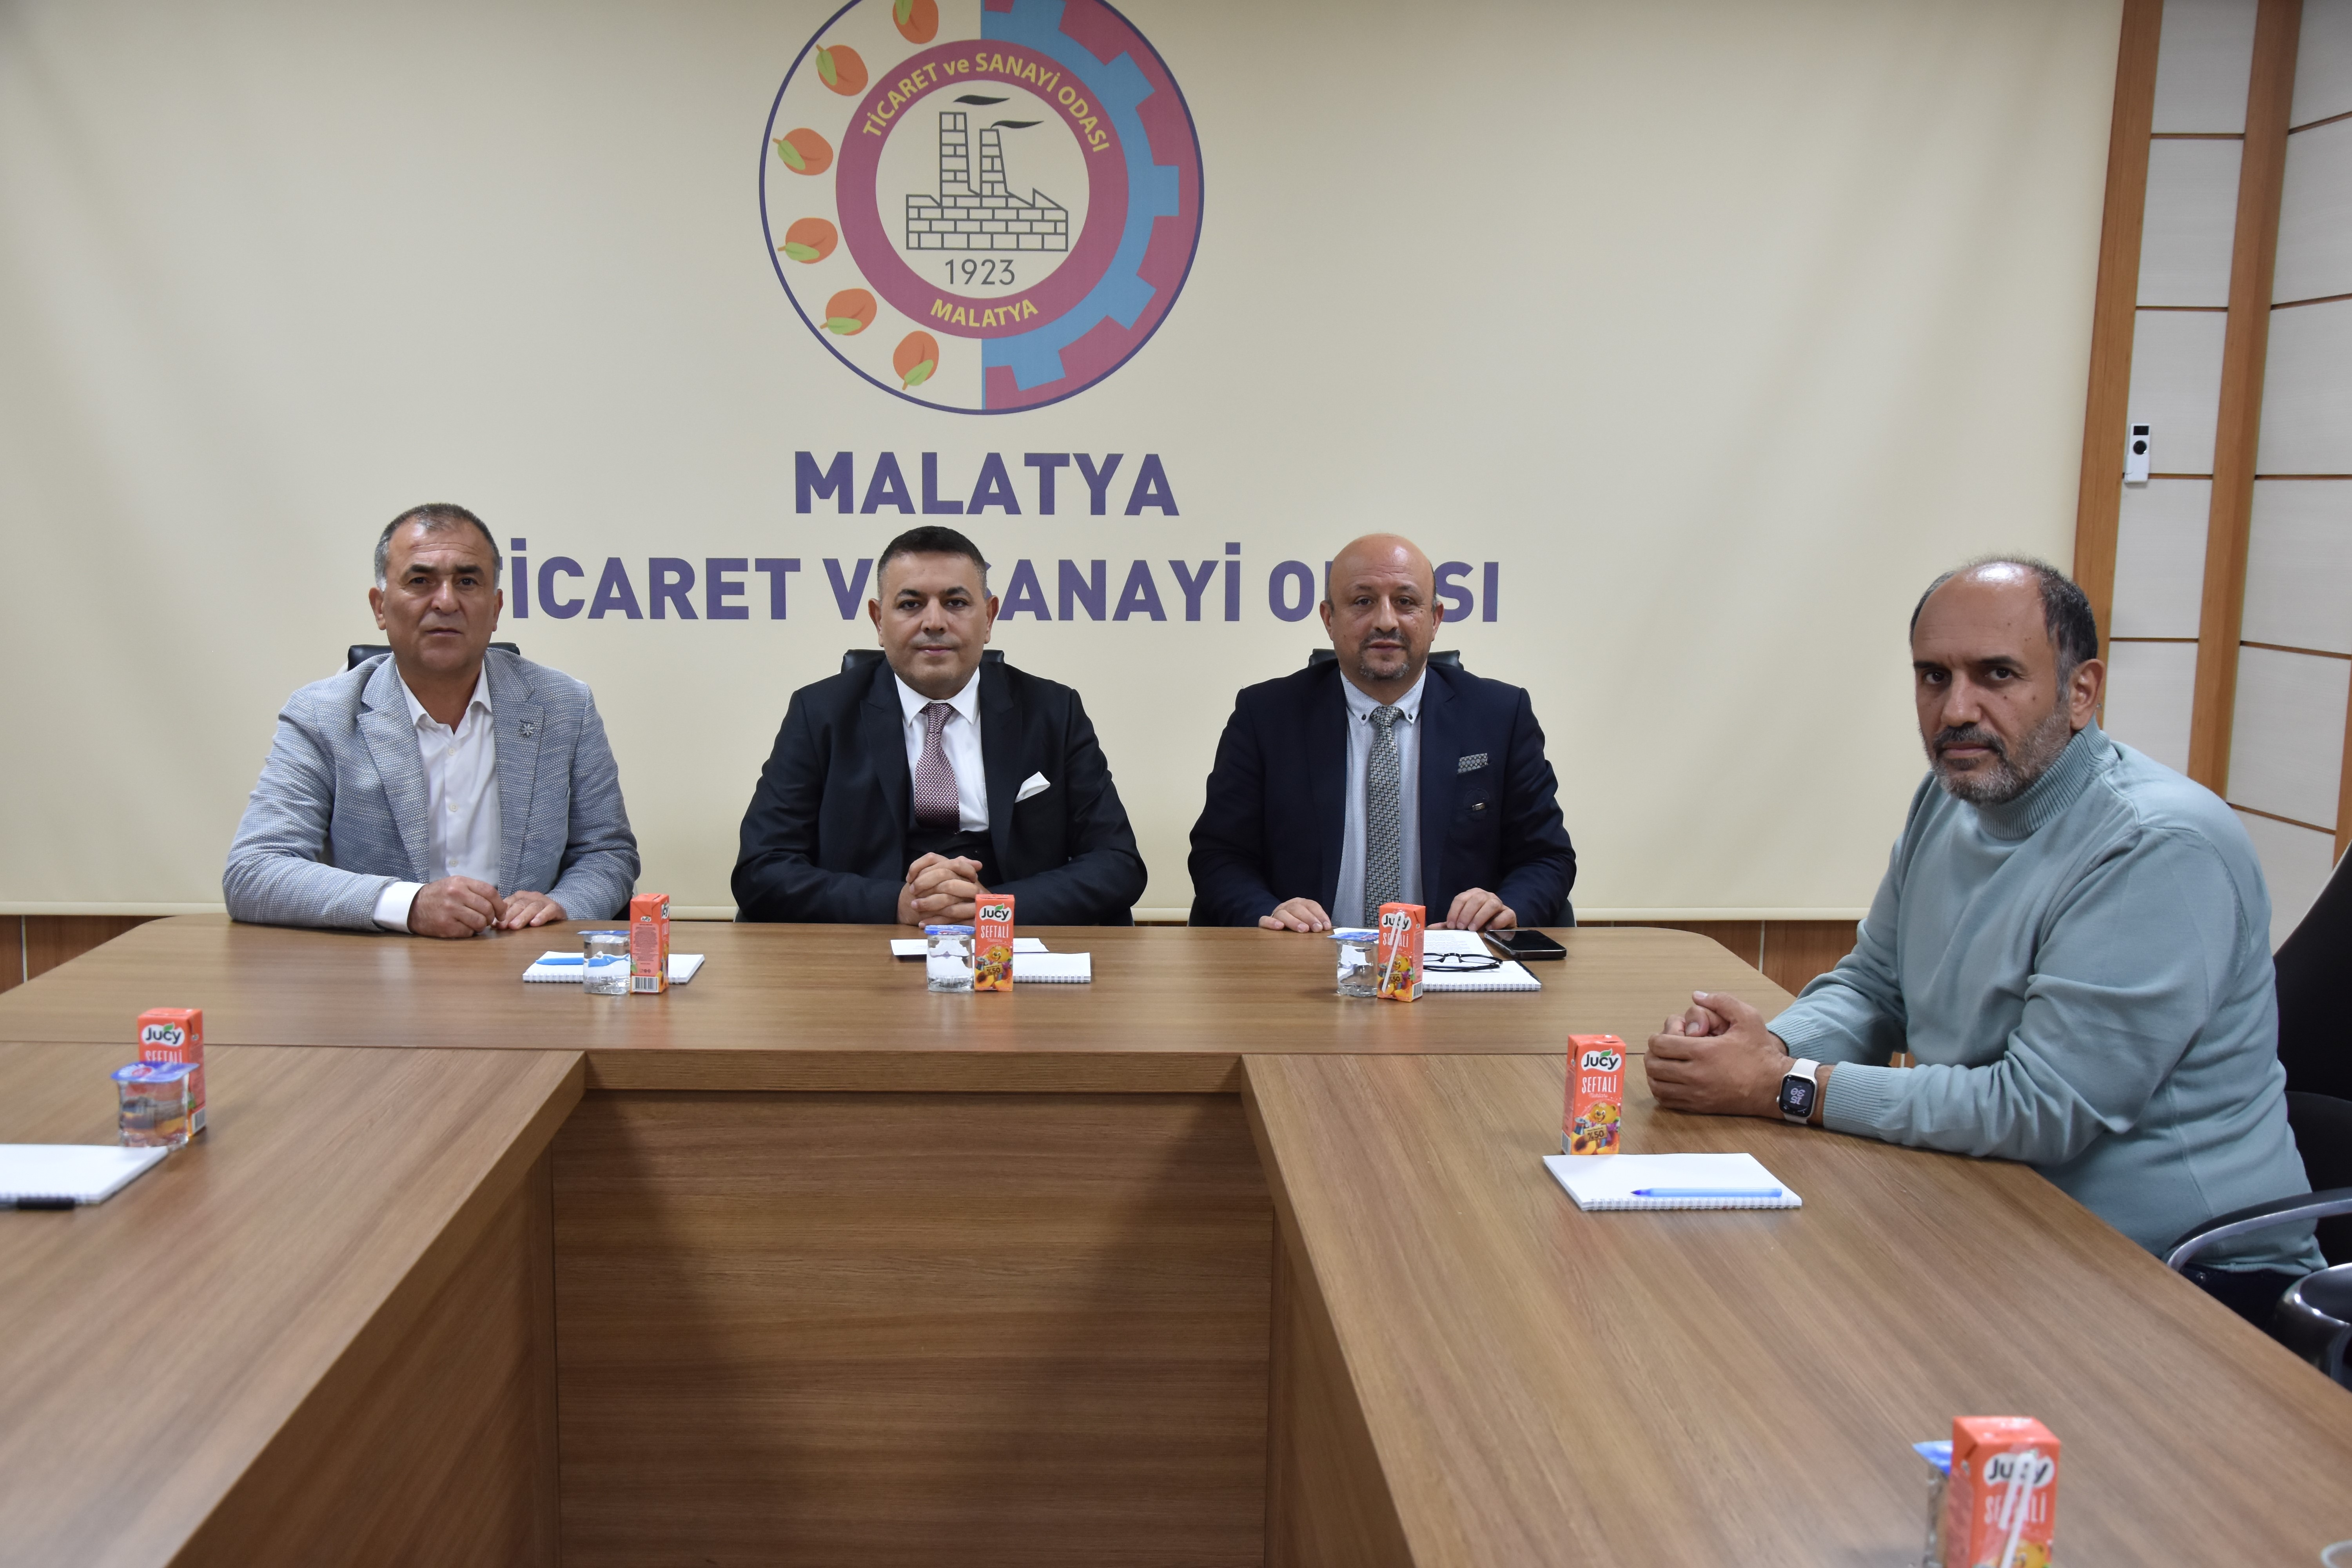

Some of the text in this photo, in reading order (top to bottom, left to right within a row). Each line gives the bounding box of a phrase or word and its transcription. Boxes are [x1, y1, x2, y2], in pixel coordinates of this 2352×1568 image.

[862, 52, 1110, 152] TİCARET ve SANAYİ ODASI
[945, 258, 1015, 285] 1923
[930, 298, 1039, 327] MALATYA
[795, 452, 1179, 516] MALATYA
[500, 537, 1499, 622] İCARET V ANAYİ OSI
[981, 907, 1009, 921] Jucy
[981, 924, 1009, 938] ŞEFTALİ
[145, 1027, 181, 1044] Jucy
[1584, 1054, 1619, 1070] Jucy
[1582, 1074, 1617, 1094] ŞEFTALİ
[1790, 1087, 1805, 1097] 30
[1790, 1095, 1802, 1105] 15
[1587, 1130, 1604, 1140] %50
